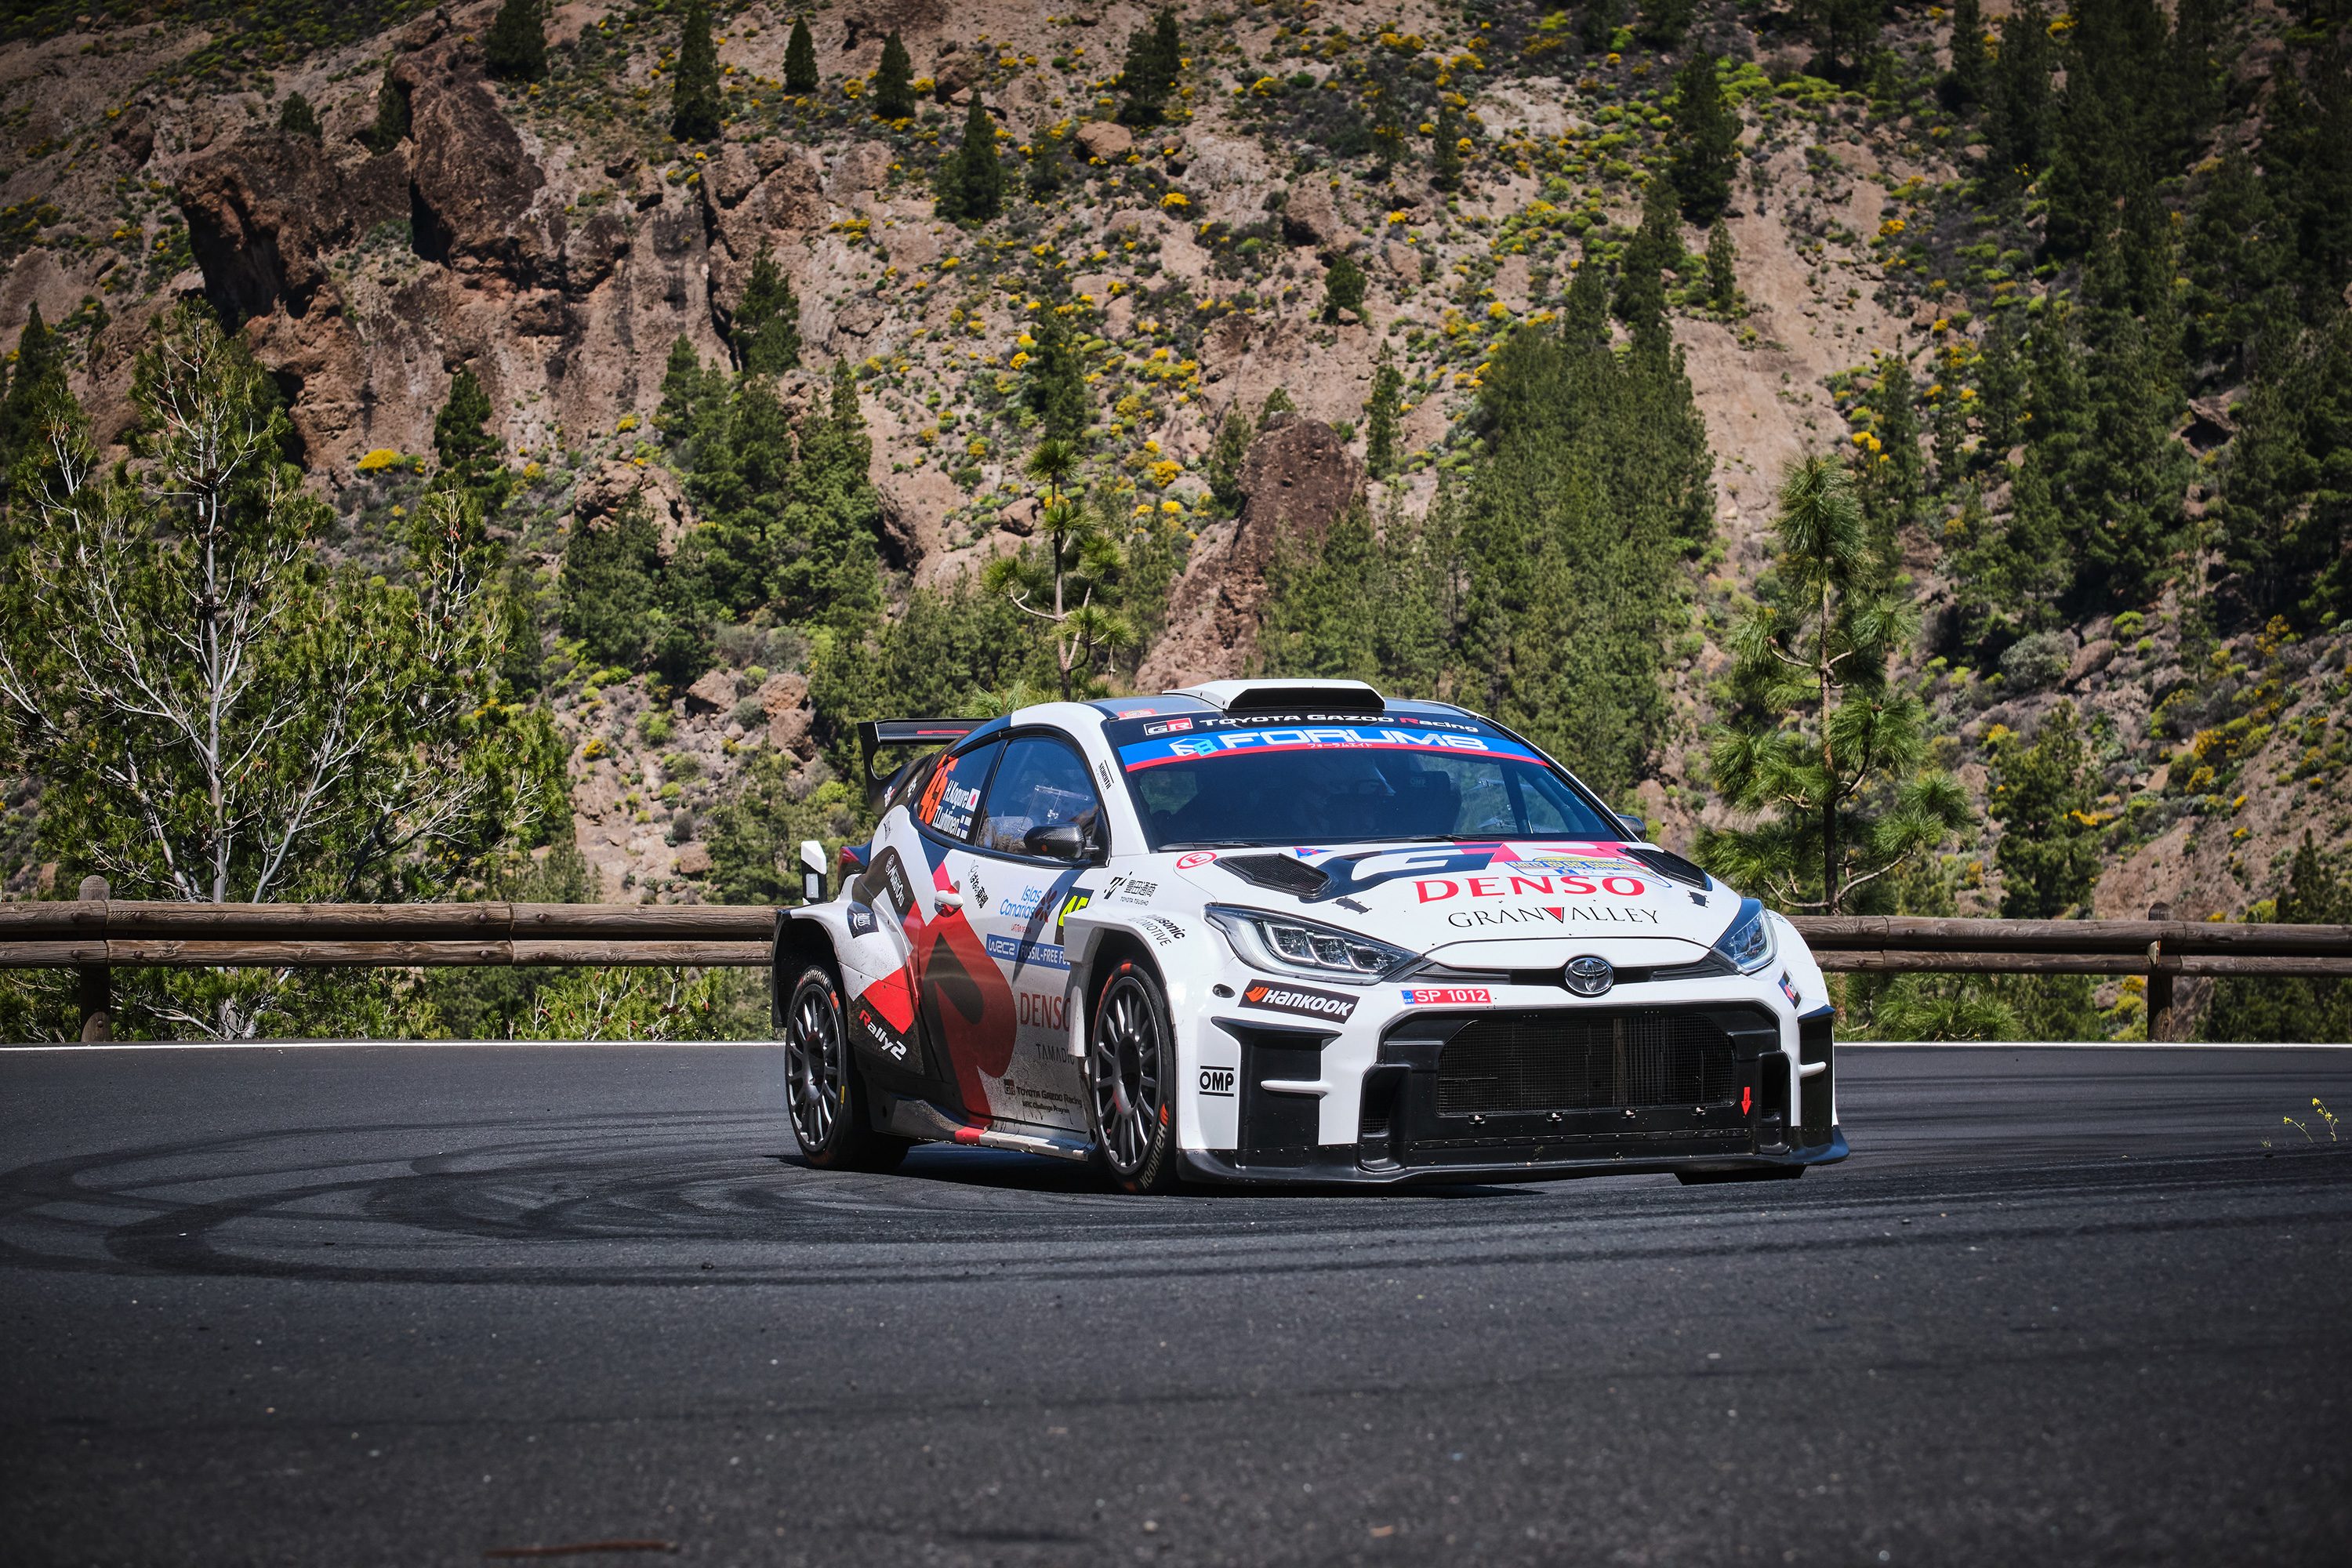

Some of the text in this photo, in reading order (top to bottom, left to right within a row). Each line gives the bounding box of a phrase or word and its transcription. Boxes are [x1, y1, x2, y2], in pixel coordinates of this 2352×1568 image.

[1147, 721, 1192, 735] GR
[1199, 715, 1301, 726] TOYOTA
[1399, 717, 1479, 733] Racing
[1218, 729, 1489, 750] FORUM8
[919, 753, 959, 824] 45
[942, 779, 970, 810] H.Kogure
[1021, 885, 1042, 902] Islas
[1412, 876, 1645, 904] DENSO
[1000, 898, 1035, 920] Canarias
[1021, 945, 1058, 964] FOSSIL-FREE
[1415, 990, 1441, 1002] SP
[1447, 989, 1488, 1002] 1012
[858, 1009, 907, 1061] Rally2
[1200, 1071, 1234, 1091] OMP
[1016, 1087, 1040, 1098] TOYOTA
[1064, 1093, 1083, 1108] Racing
